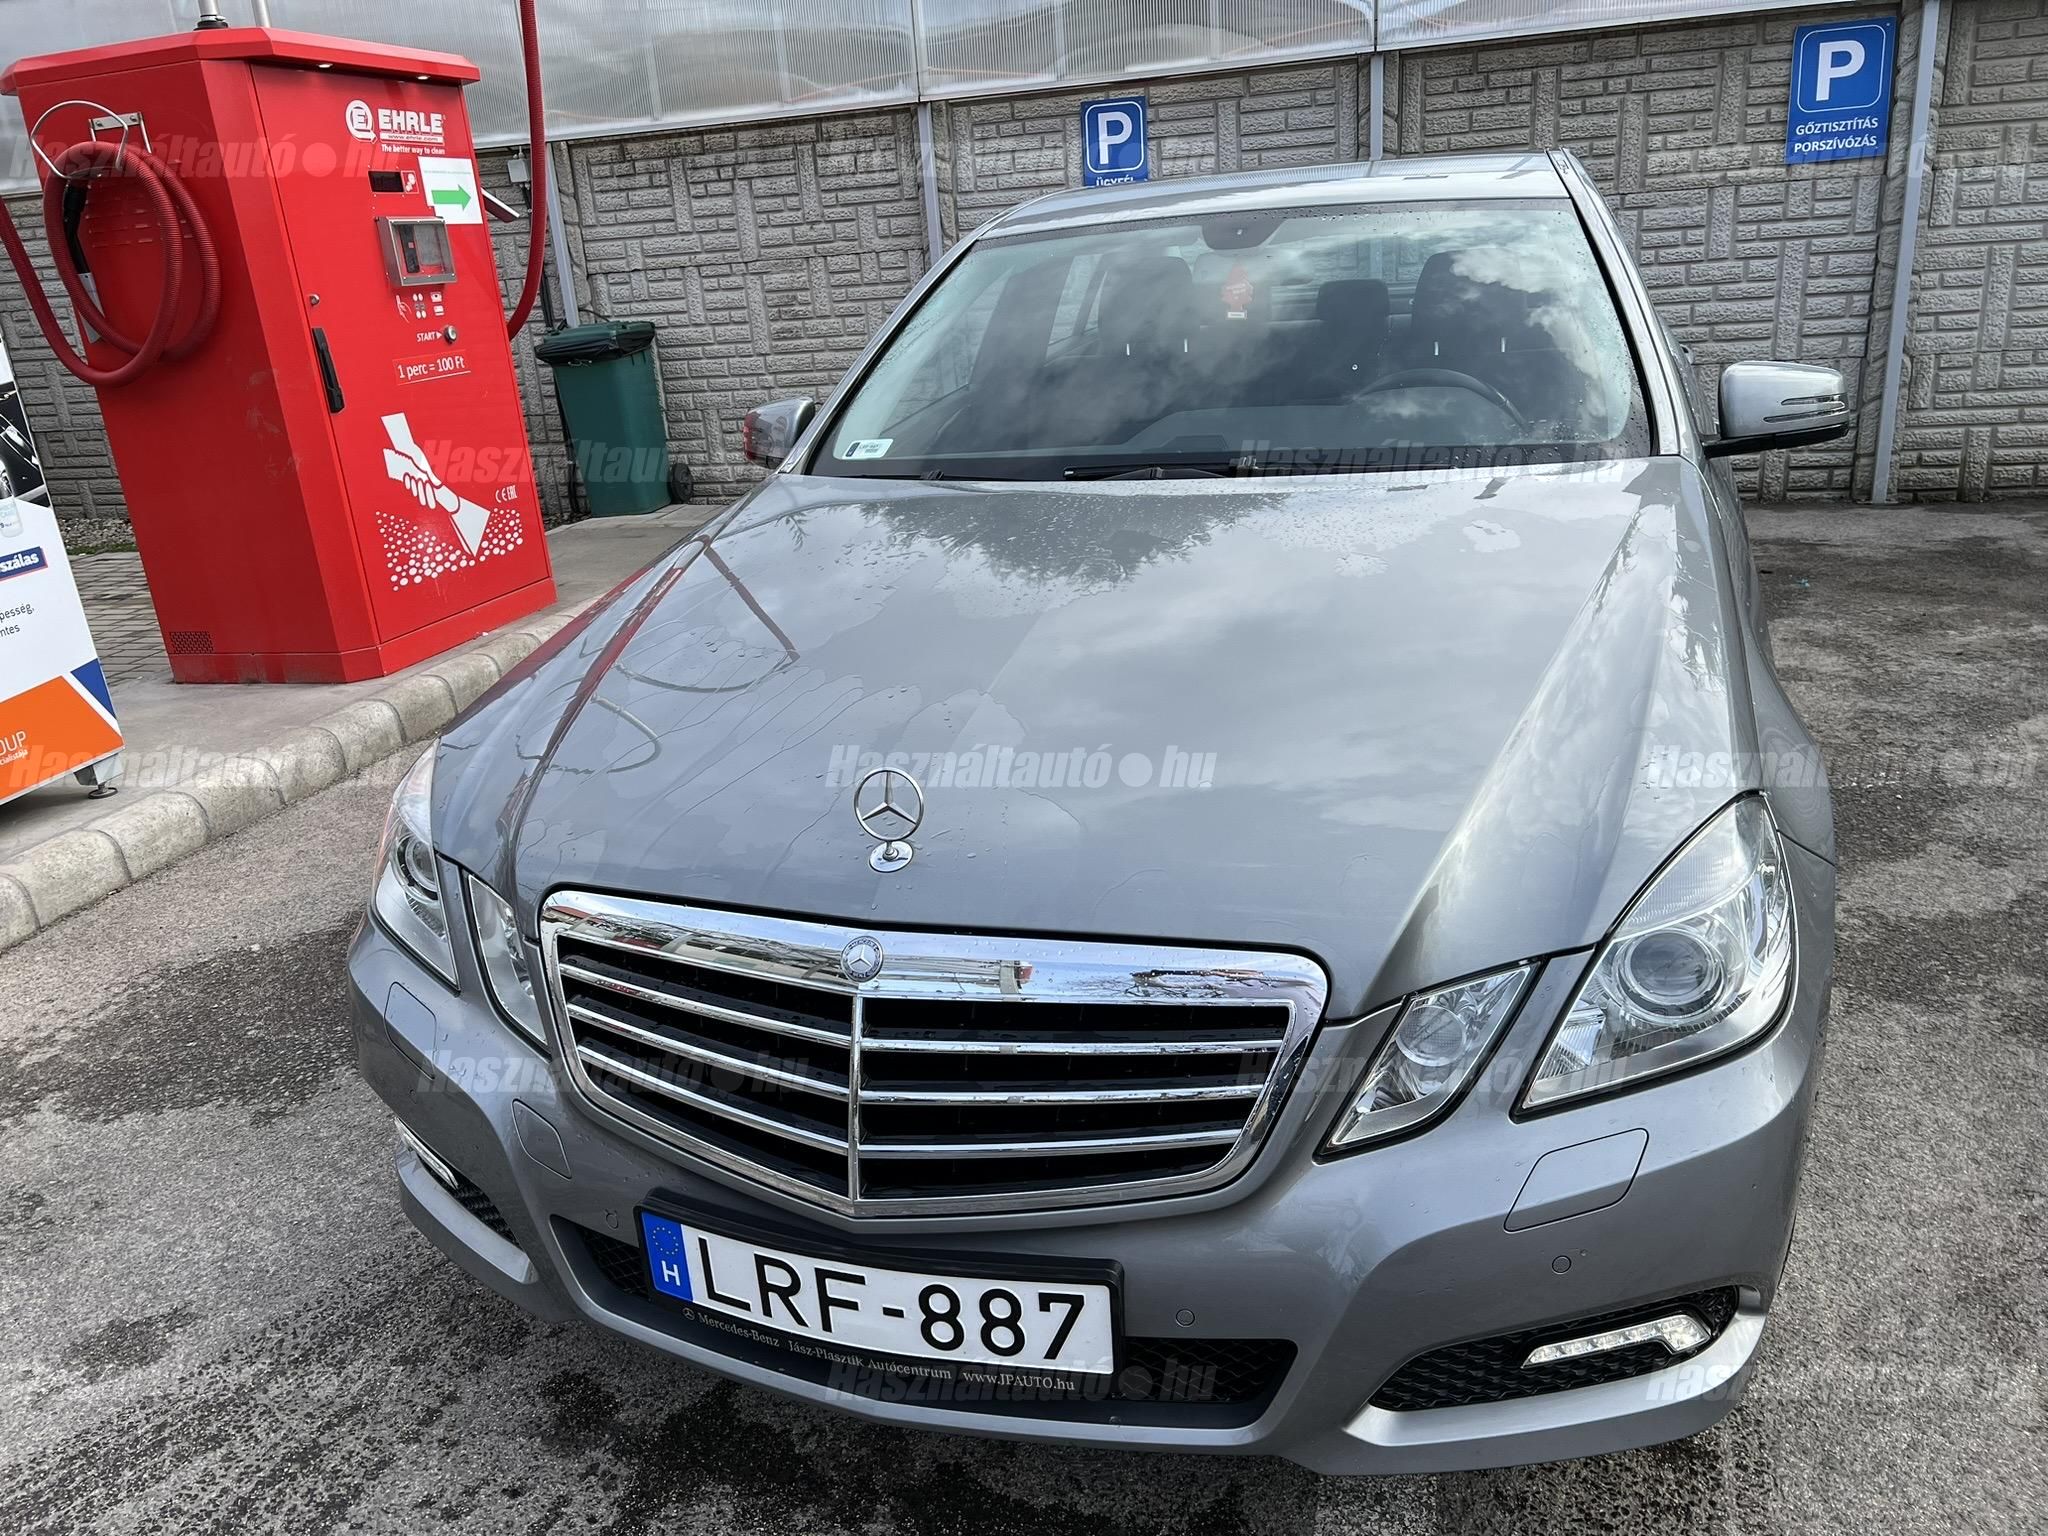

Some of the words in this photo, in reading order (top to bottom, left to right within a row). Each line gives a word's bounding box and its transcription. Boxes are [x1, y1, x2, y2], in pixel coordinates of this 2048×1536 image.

[1815, 40, 1866, 102] P
[377, 108, 443, 134] EHRLE
[1795, 116, 1879, 135] GŐZTISZTÍTÁS
[381, 144, 392, 152] The
[392, 145, 411, 153] better
[411, 147, 423, 155] way
[1097, 111, 1133, 165] P
[1794, 134, 1878, 153] PORSZÍVÓZÁS
[416, 331, 436, 342] START
[397, 364, 405, 378] 1
[406, 364, 428, 380] perc
[436, 357, 454, 372] 100
[454, 355, 465, 369] Ft
[661, 1260, 681, 1287] H
[698, 1236, 1085, 1359] LRF-887
[698, 1312, 780, 1347] Mercedes-Benz
[867, 1358, 952, 1380] Autócentrum
[962, 1370, 1076, 1392] www.JPAUTO.hu
